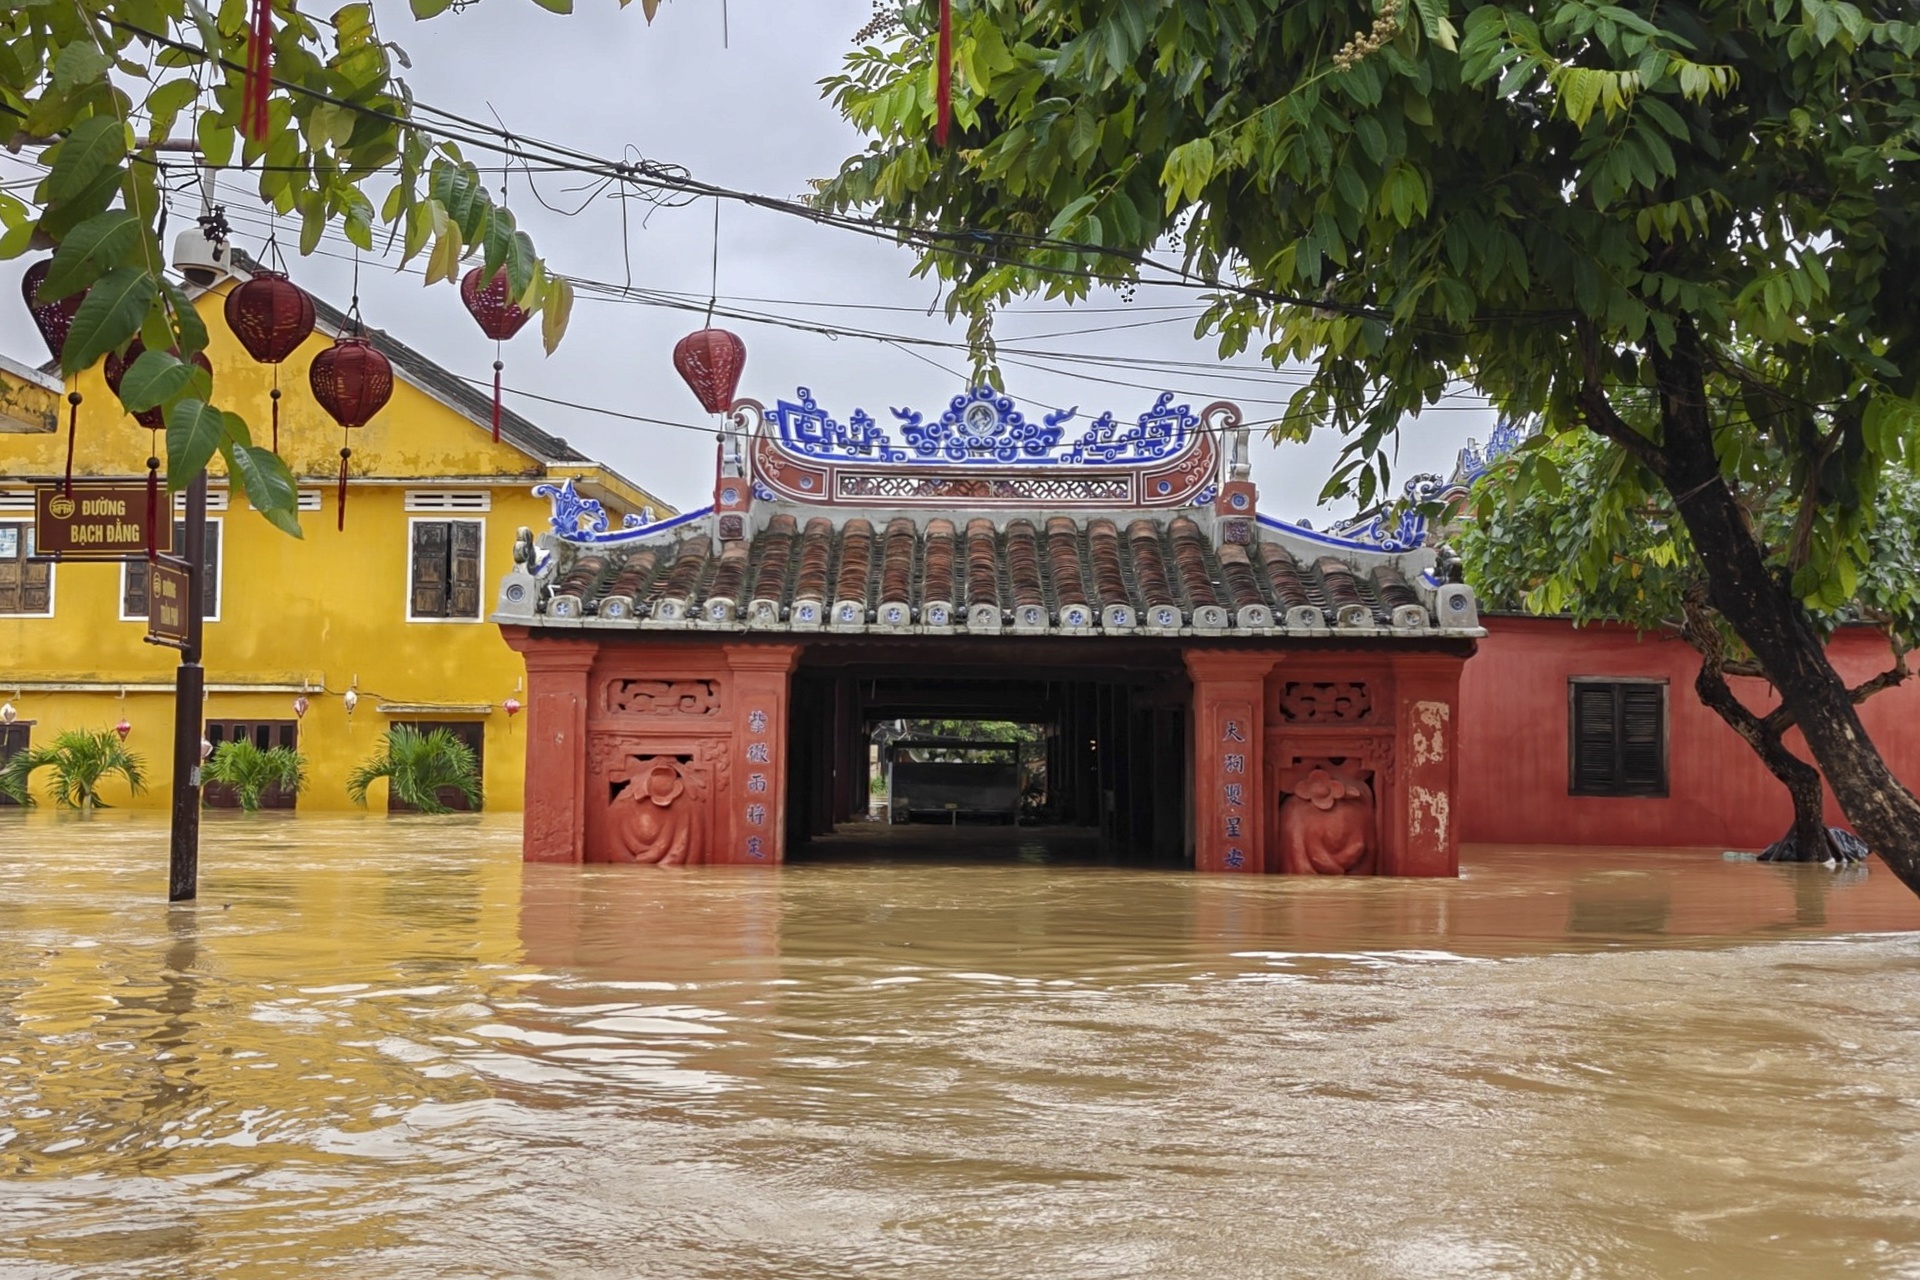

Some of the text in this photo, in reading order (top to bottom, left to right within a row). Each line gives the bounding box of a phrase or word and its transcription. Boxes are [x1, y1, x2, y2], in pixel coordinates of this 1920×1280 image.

[82, 496, 126, 516] ĐƯỜNG
[70, 518, 140, 545] BẠCH ĐẰNG
